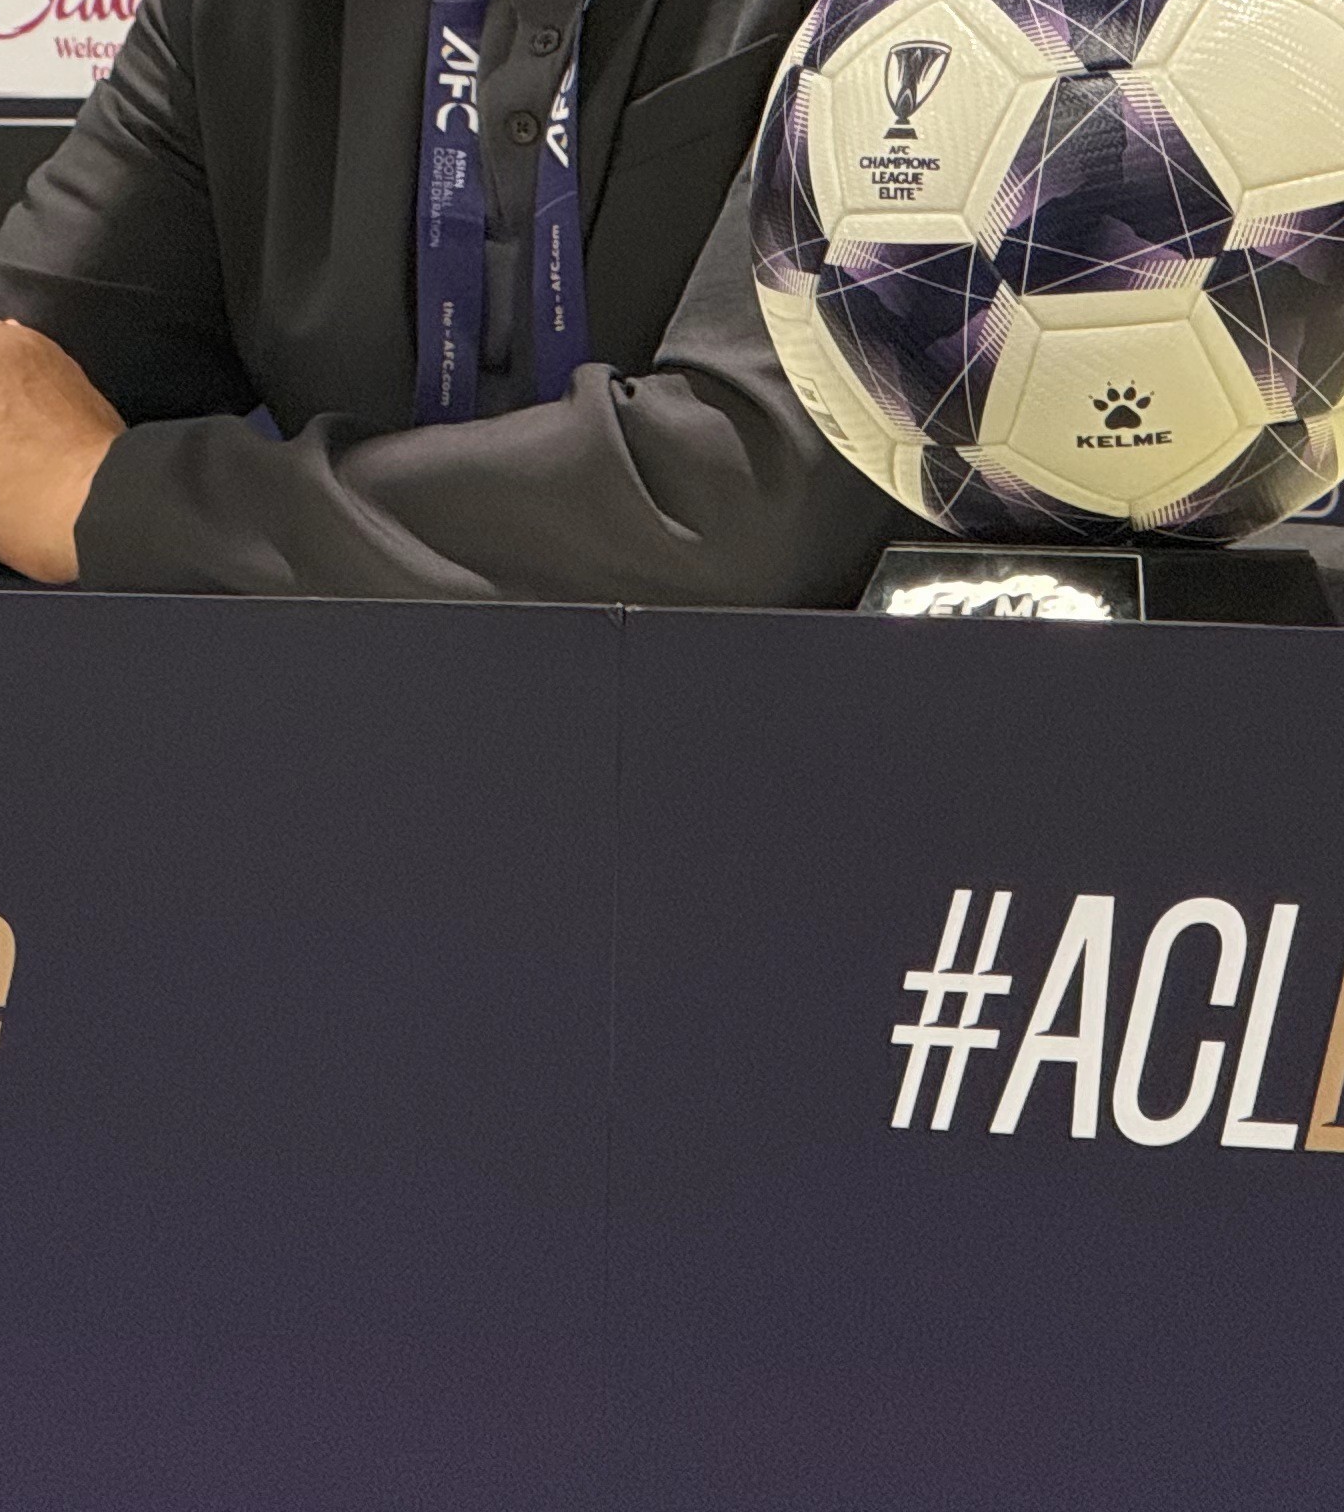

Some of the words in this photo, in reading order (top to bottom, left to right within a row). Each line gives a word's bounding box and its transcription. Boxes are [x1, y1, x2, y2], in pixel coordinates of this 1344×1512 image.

[53, 36, 123, 58] Welco
[436, 26, 479, 135] AFC
[889, 145, 911, 155] AFC
[455, 150, 467, 189] ASIAN
[859, 156, 941, 171] CHAMPIONS
[872, 171, 924, 185] LEAGUE
[1076, 430, 1173, 449] KELME
